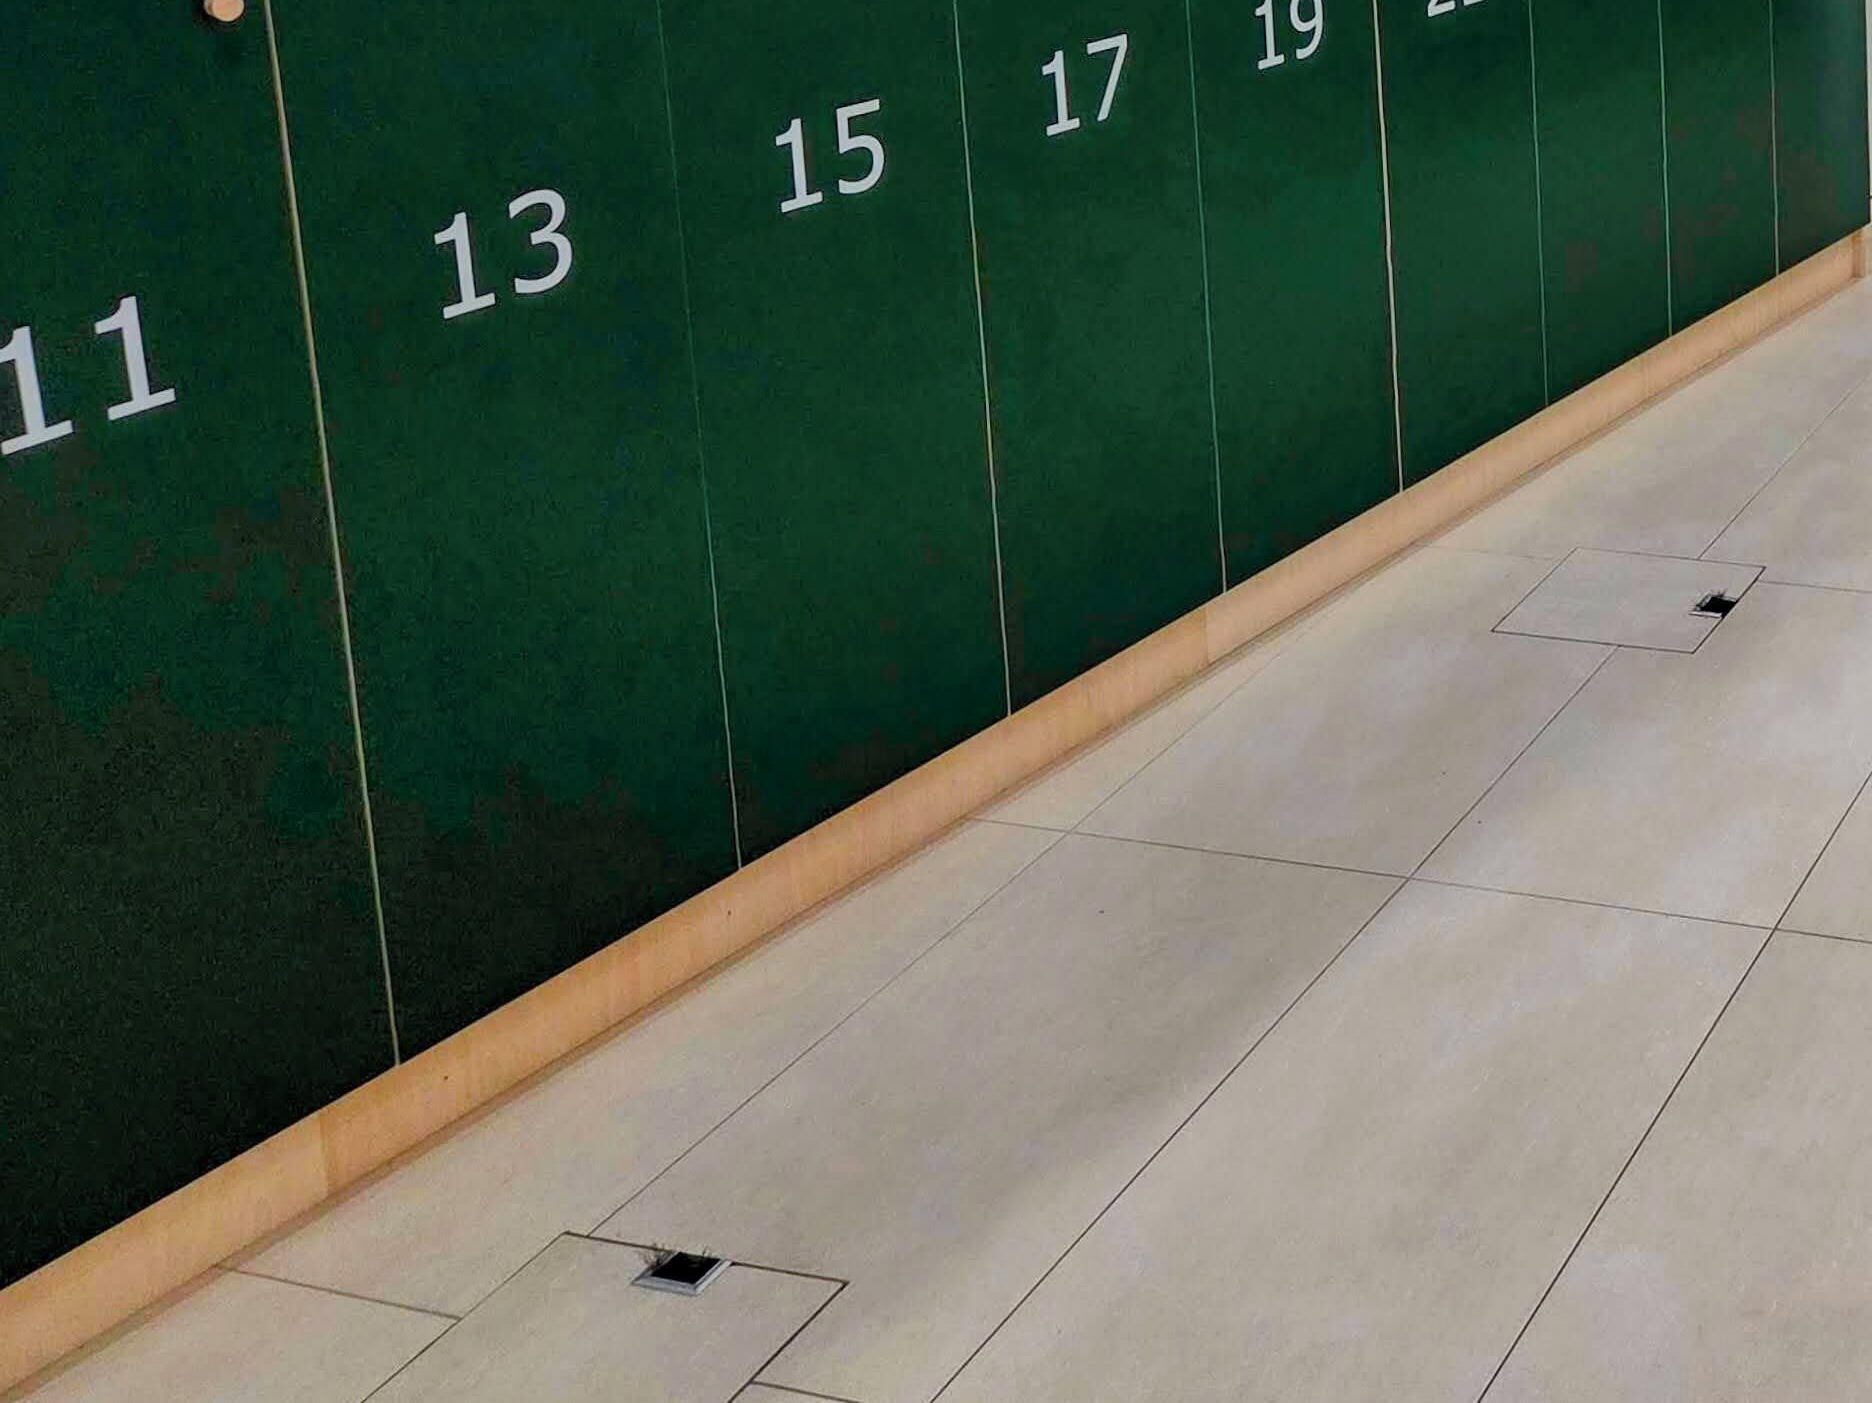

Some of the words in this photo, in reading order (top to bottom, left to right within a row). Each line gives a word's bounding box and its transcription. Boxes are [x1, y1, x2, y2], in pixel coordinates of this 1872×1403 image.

[1041, 33, 1128, 137] 17
[775, 98, 885, 213] 15
[434, 189, 573, 319] 13
[0, 295, 176, 455] 11
